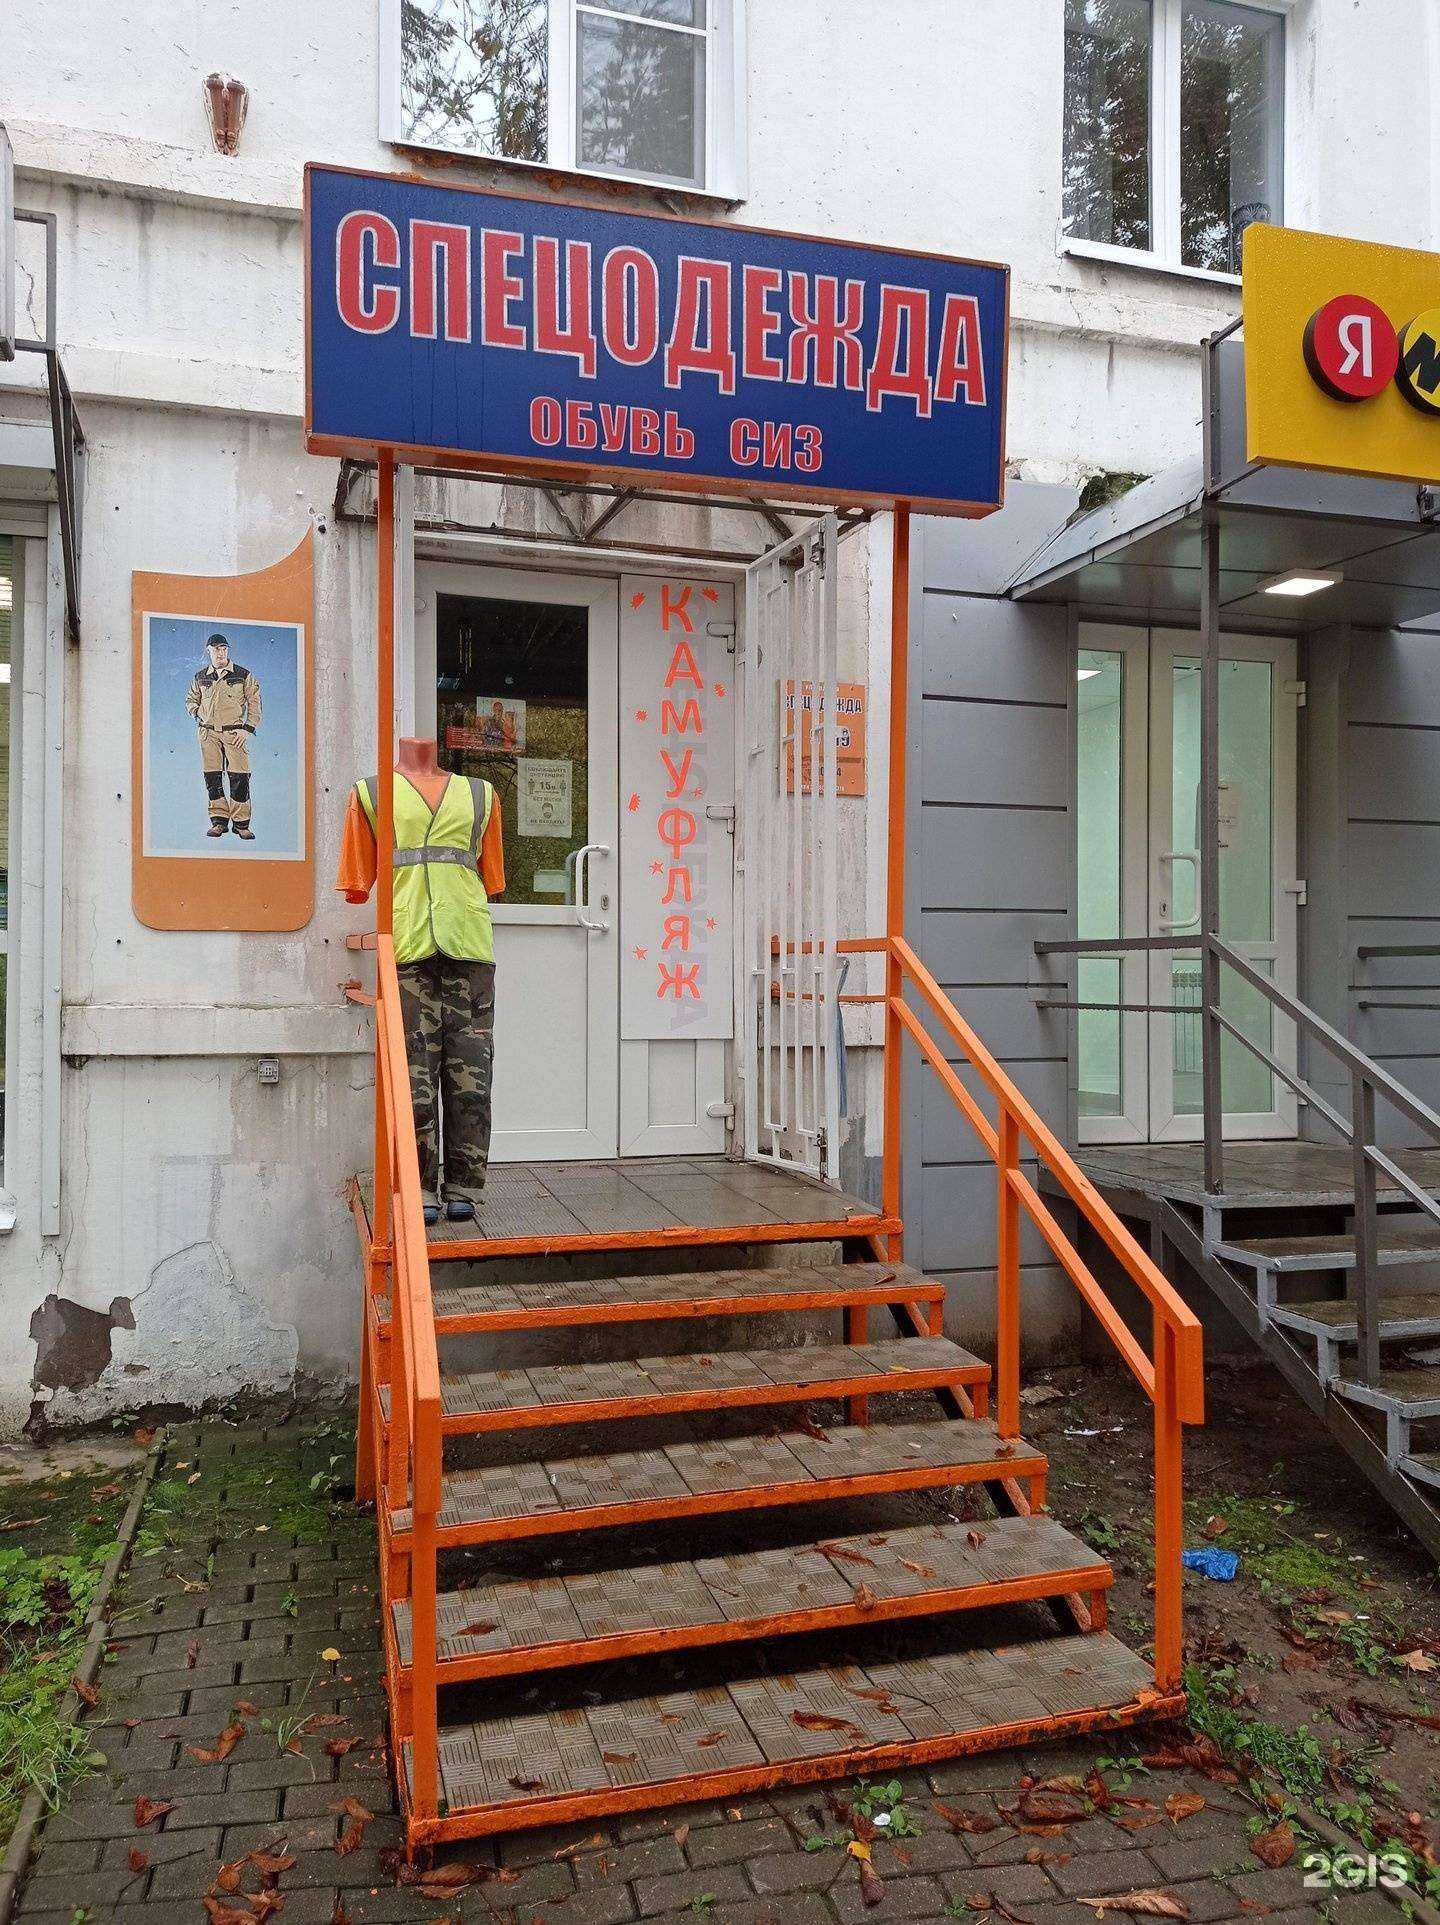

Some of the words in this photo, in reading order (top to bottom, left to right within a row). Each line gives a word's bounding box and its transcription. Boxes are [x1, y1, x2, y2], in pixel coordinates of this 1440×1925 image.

[335, 209, 987, 419] СПЕЦОДЕЖДА
[1338, 314, 1374, 378] Я
[529, 396, 695, 460] ОБУВЬ
[729, 417, 824, 473] СИЗ
[656, 584, 704, 999] КАМУФЛЯЖ
